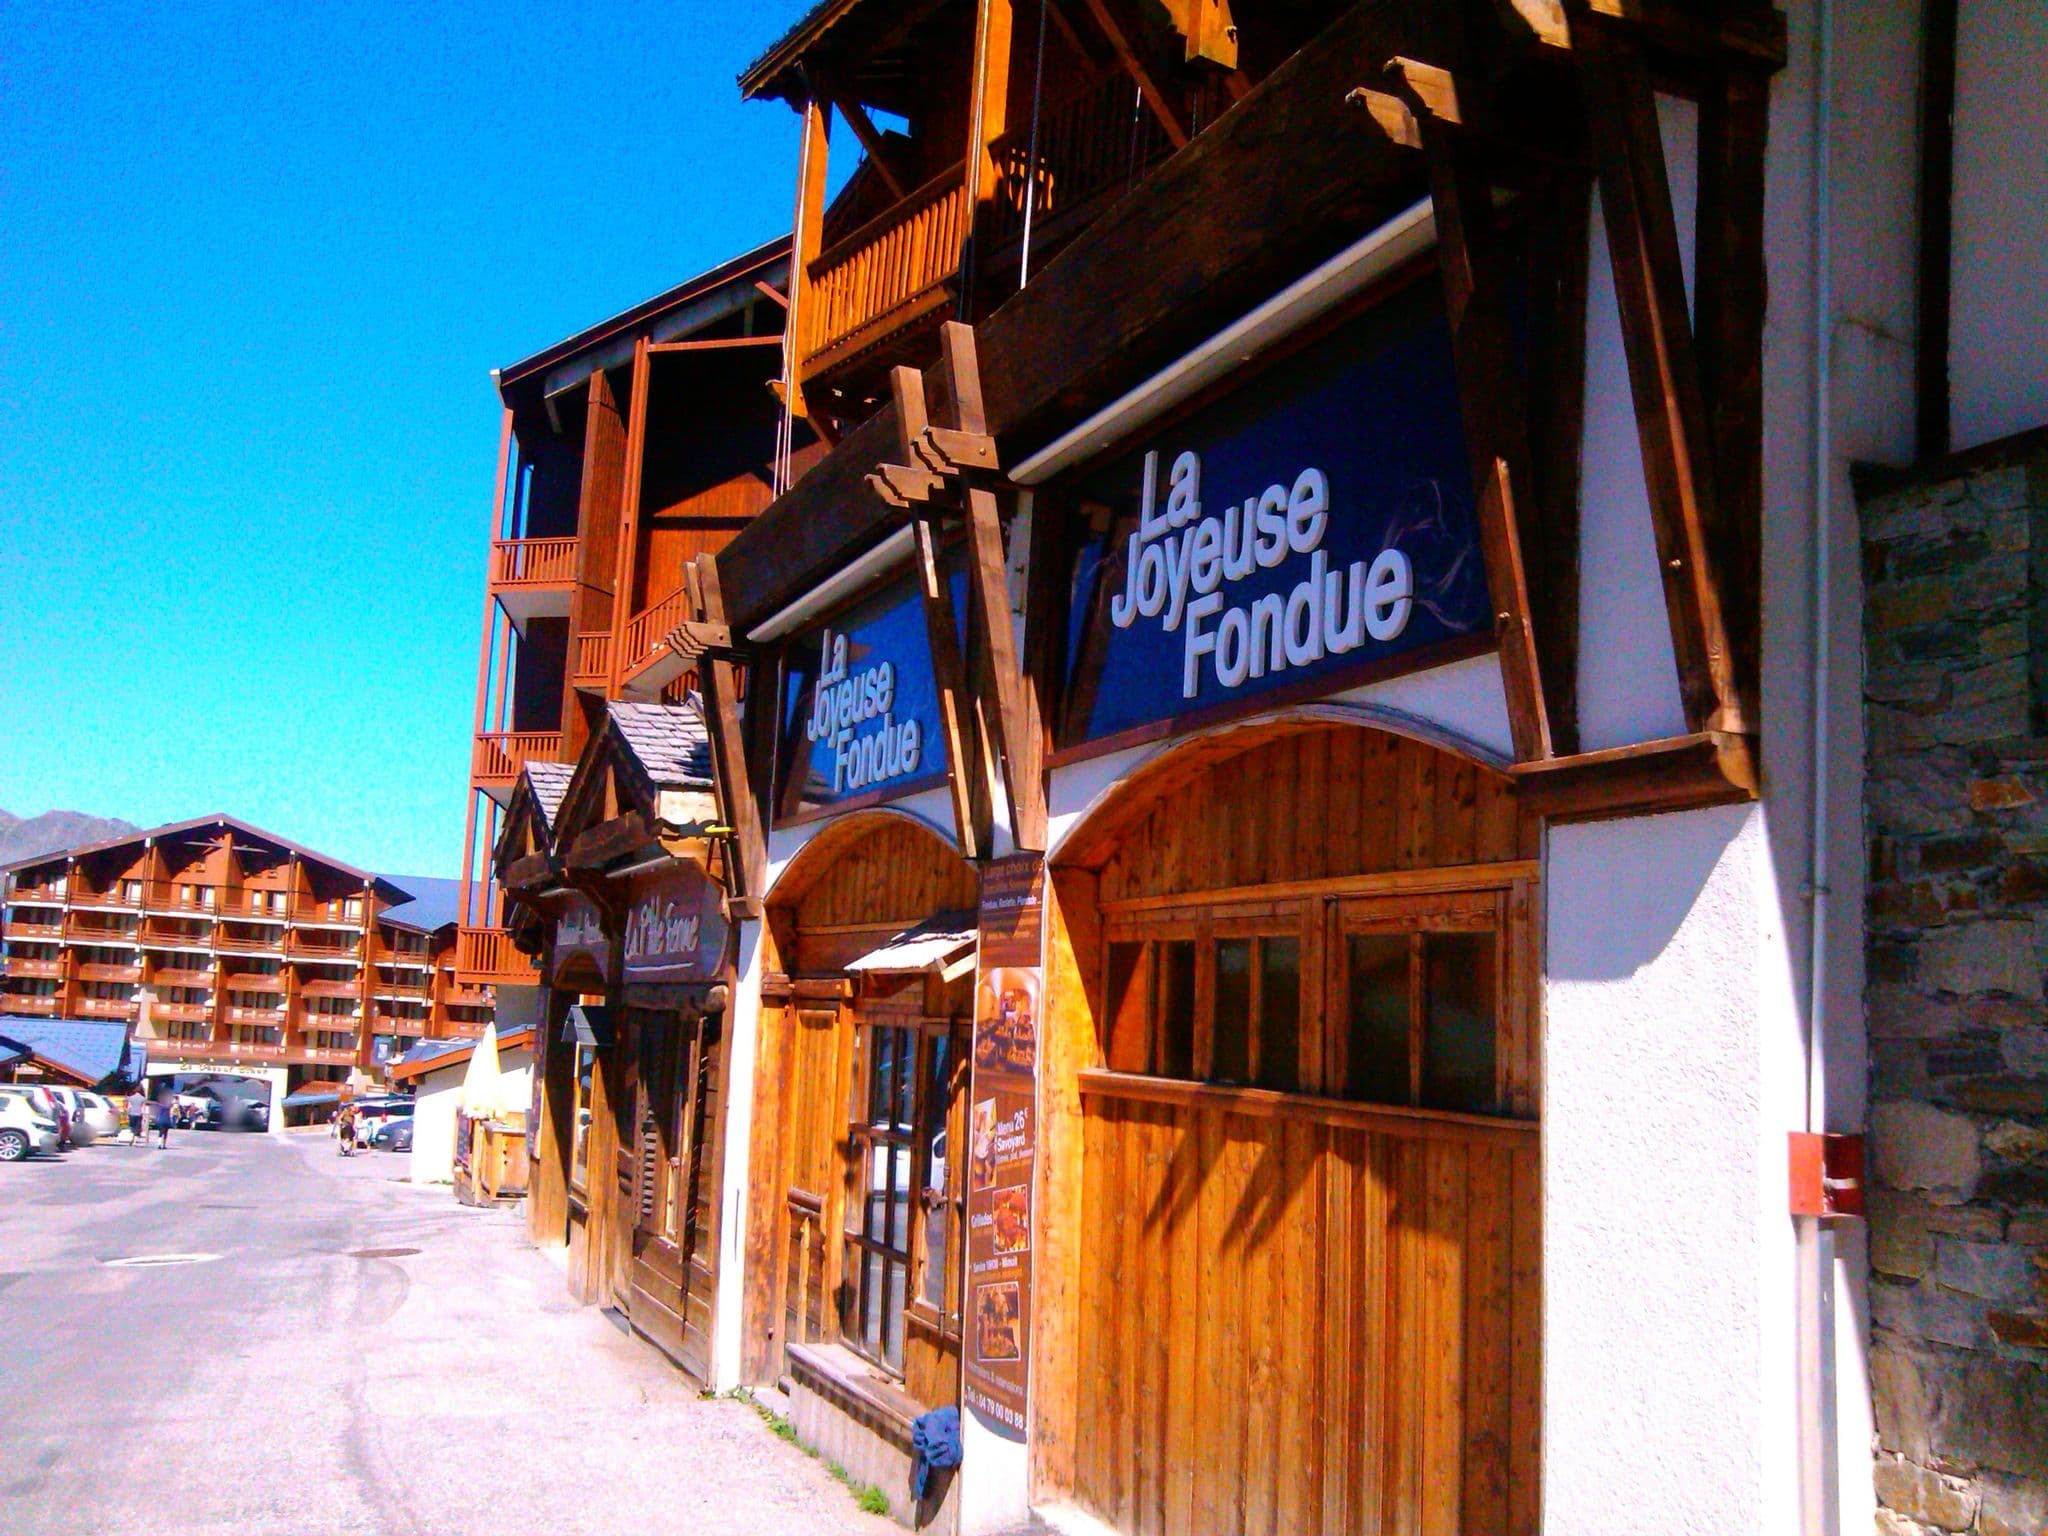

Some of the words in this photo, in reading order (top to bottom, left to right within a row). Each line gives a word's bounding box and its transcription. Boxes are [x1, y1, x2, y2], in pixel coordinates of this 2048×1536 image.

[1141, 450, 1201, 542] La
[1112, 467, 1329, 632] Joyeuse
[821, 629, 848, 688] La
[1183, 548, 1414, 699] Fondue
[807, 661, 894, 748] Joyeuse
[834, 712, 921, 792] Fondue
[997, 1121, 1014, 1135] Menu
[997, 1131, 1026, 1153] Savoyard
